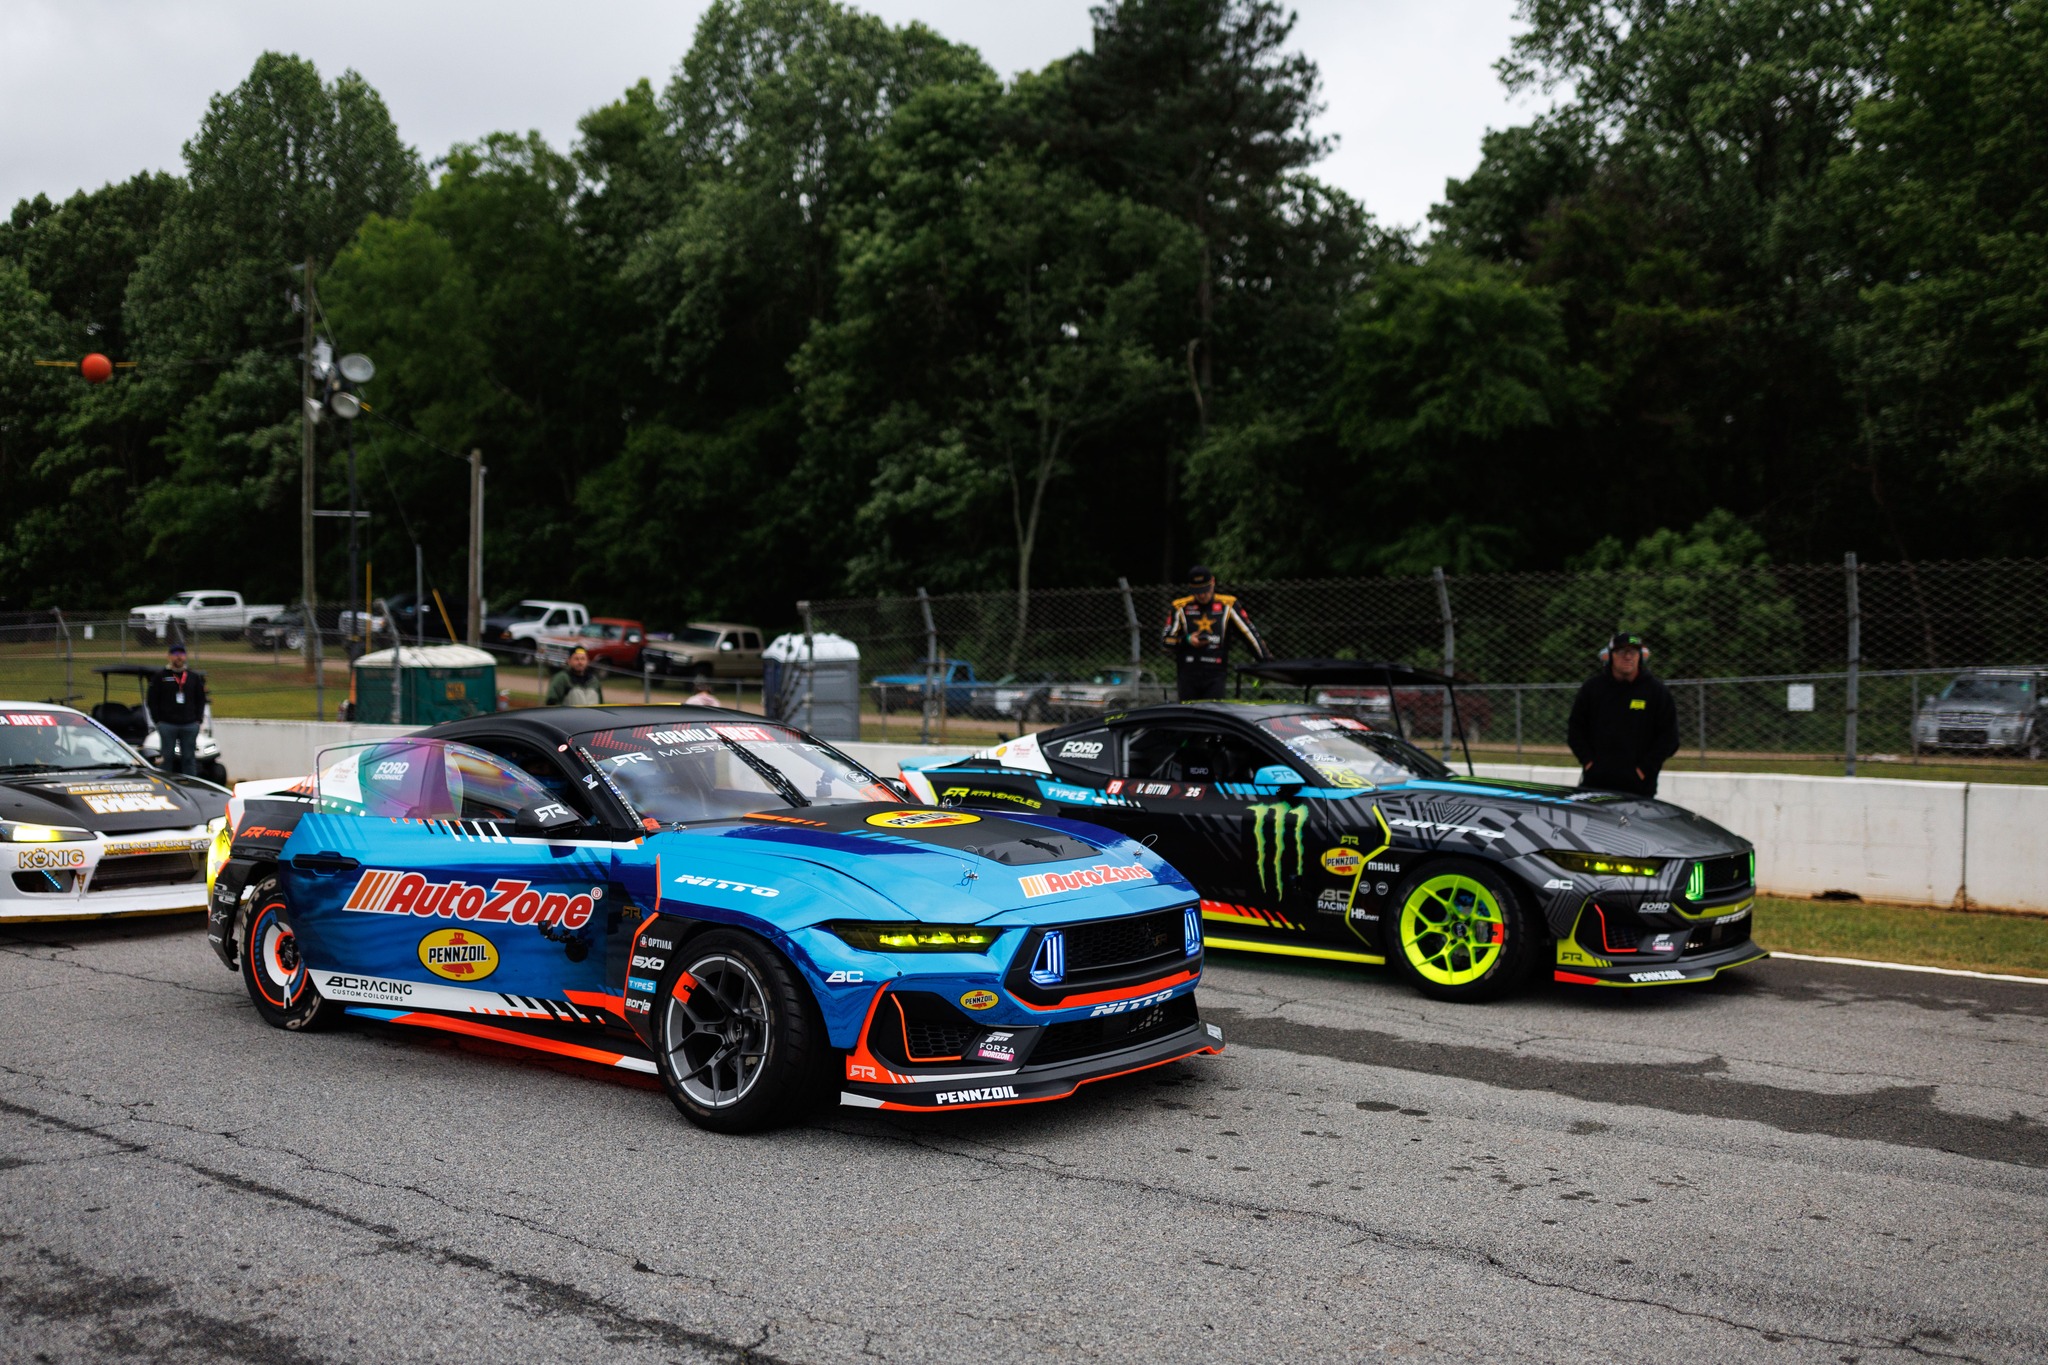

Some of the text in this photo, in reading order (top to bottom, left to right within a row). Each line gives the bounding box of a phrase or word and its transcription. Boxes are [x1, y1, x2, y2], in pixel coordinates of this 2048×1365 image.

[9, 714, 54, 726] DRIFT
[646, 726, 771, 745] FORMULA DRIFT
[1061, 741, 1104, 754] FORD
[376, 762, 410, 774] FORD
[1145, 783, 1171, 796] GITTIN
[1185, 786, 1202, 797] 25
[992, 791, 1042, 809] VEHICLES
[1389, 818, 1506, 838] NITTO
[104, 840, 190, 851] TREADSTONE
[19, 848, 85, 869] KÖNIG
[1326, 855, 1360, 867] PENNZOIL
[1367, 861, 1400, 873] MAHLE
[674, 874, 780, 898] NITTO
[1639, 902, 1670, 911] FORD
[648, 937, 673, 950] OPTIMA
[428, 944, 489, 964] PENNZOIL
[825, 970, 864, 983] BC
[1629, 969, 1687, 983] PENNZOIL
[332, 988, 404, 1002] CUSTOM COILOVERS
[964, 993, 996, 1005] PENNZOIL
[1090, 989, 1174, 1018] NITTO
[979, 1042, 1015, 1055] FORZA
[982, 1051, 1013, 1061] HORIZON
[935, 1085, 1020, 1105] PENNZOIL
